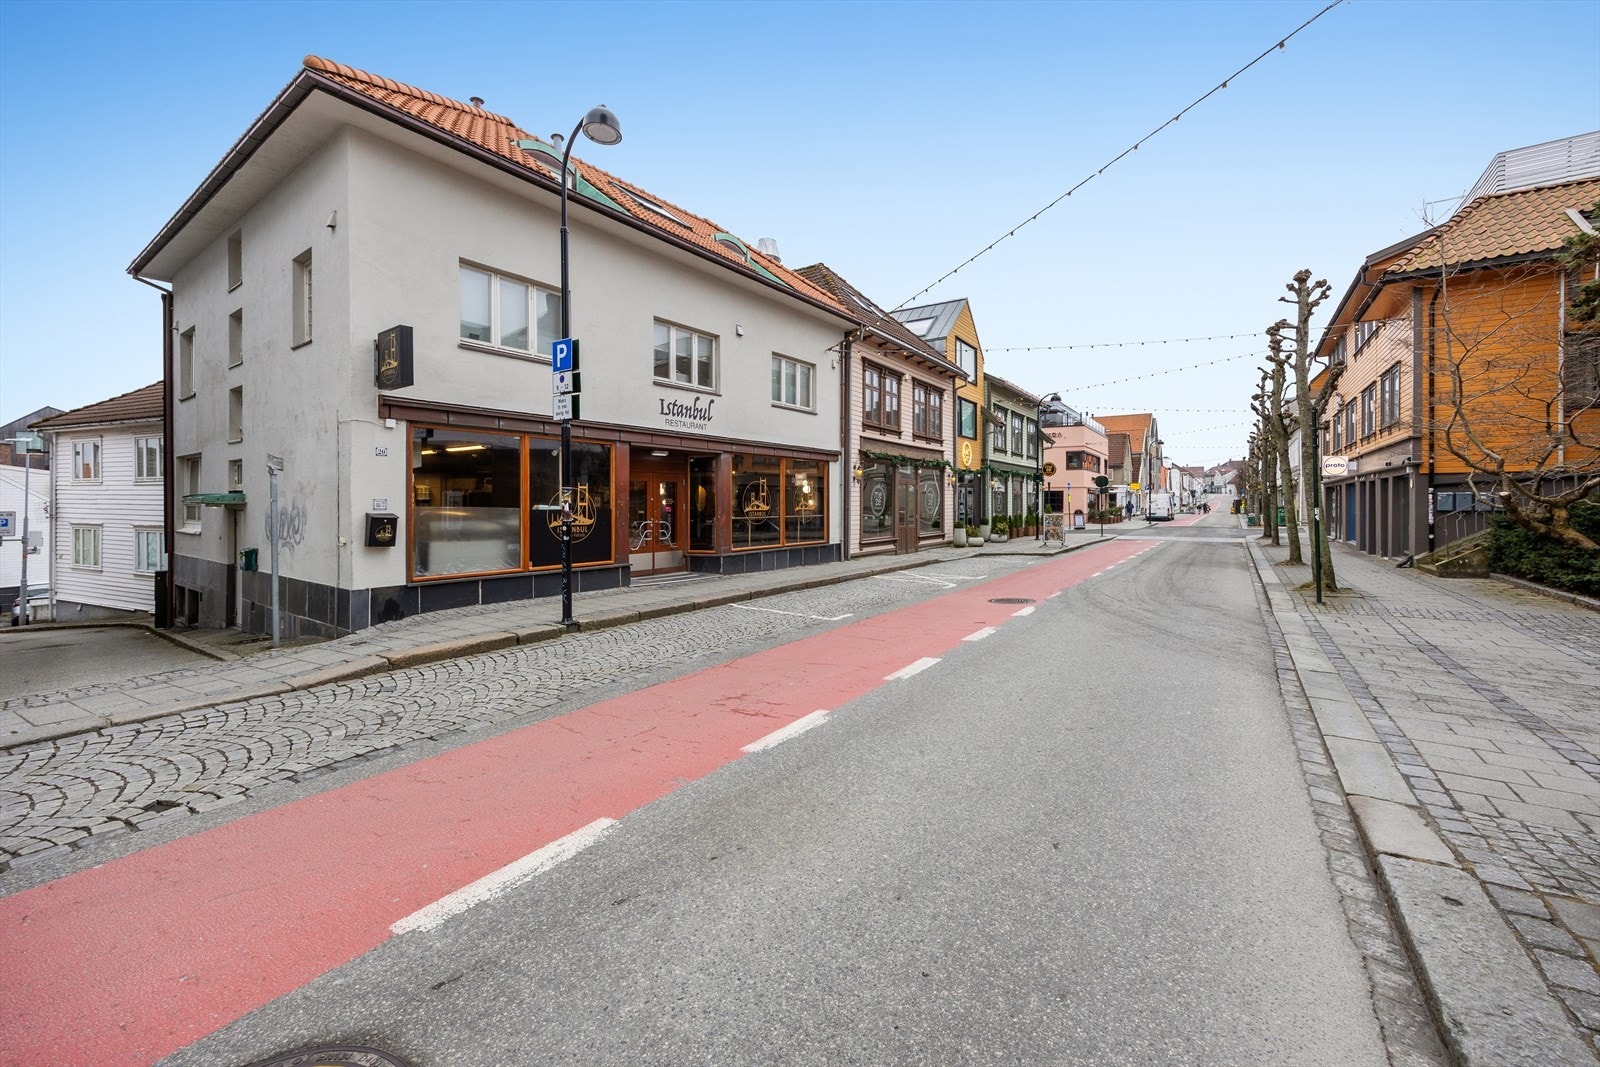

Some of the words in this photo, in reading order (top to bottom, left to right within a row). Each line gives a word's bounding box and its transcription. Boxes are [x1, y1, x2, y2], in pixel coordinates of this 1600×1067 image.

[557, 344, 567, 368] P
[659, 396, 715, 422] Istanbul
[664, 418, 708, 431] RESTAURANT
[377, 448, 386, 456] 20
